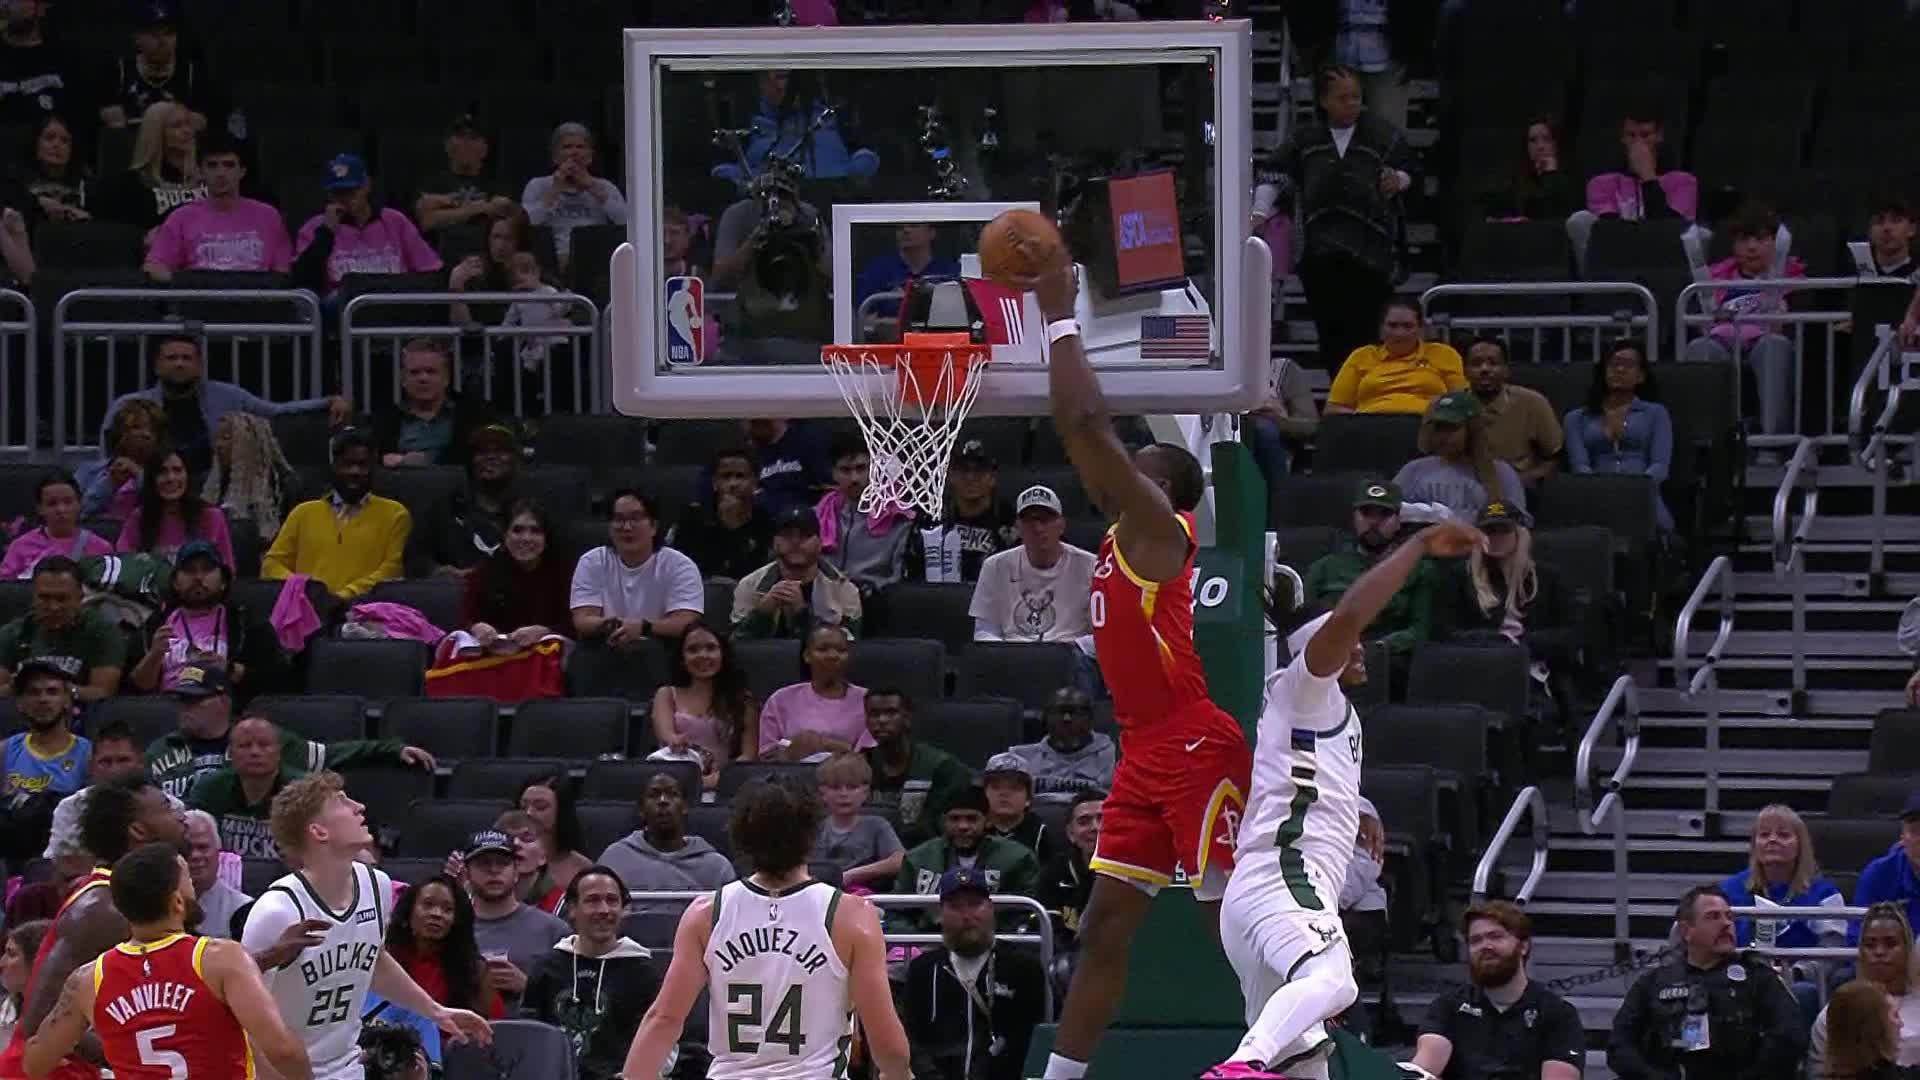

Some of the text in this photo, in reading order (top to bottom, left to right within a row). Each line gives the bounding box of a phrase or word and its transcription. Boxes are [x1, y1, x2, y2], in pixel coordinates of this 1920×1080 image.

[152, 185, 209, 216] BUCK
[671, 345, 690, 360] NBA
[301, 942, 378, 986] BUCKS
[714, 927, 828, 975] JAQUEZ JR
[105, 981, 196, 1025] VANVLEET
[307, 984, 354, 1026] 25
[728, 983, 806, 1055] 24
[136, 1023, 188, 1080] 5
